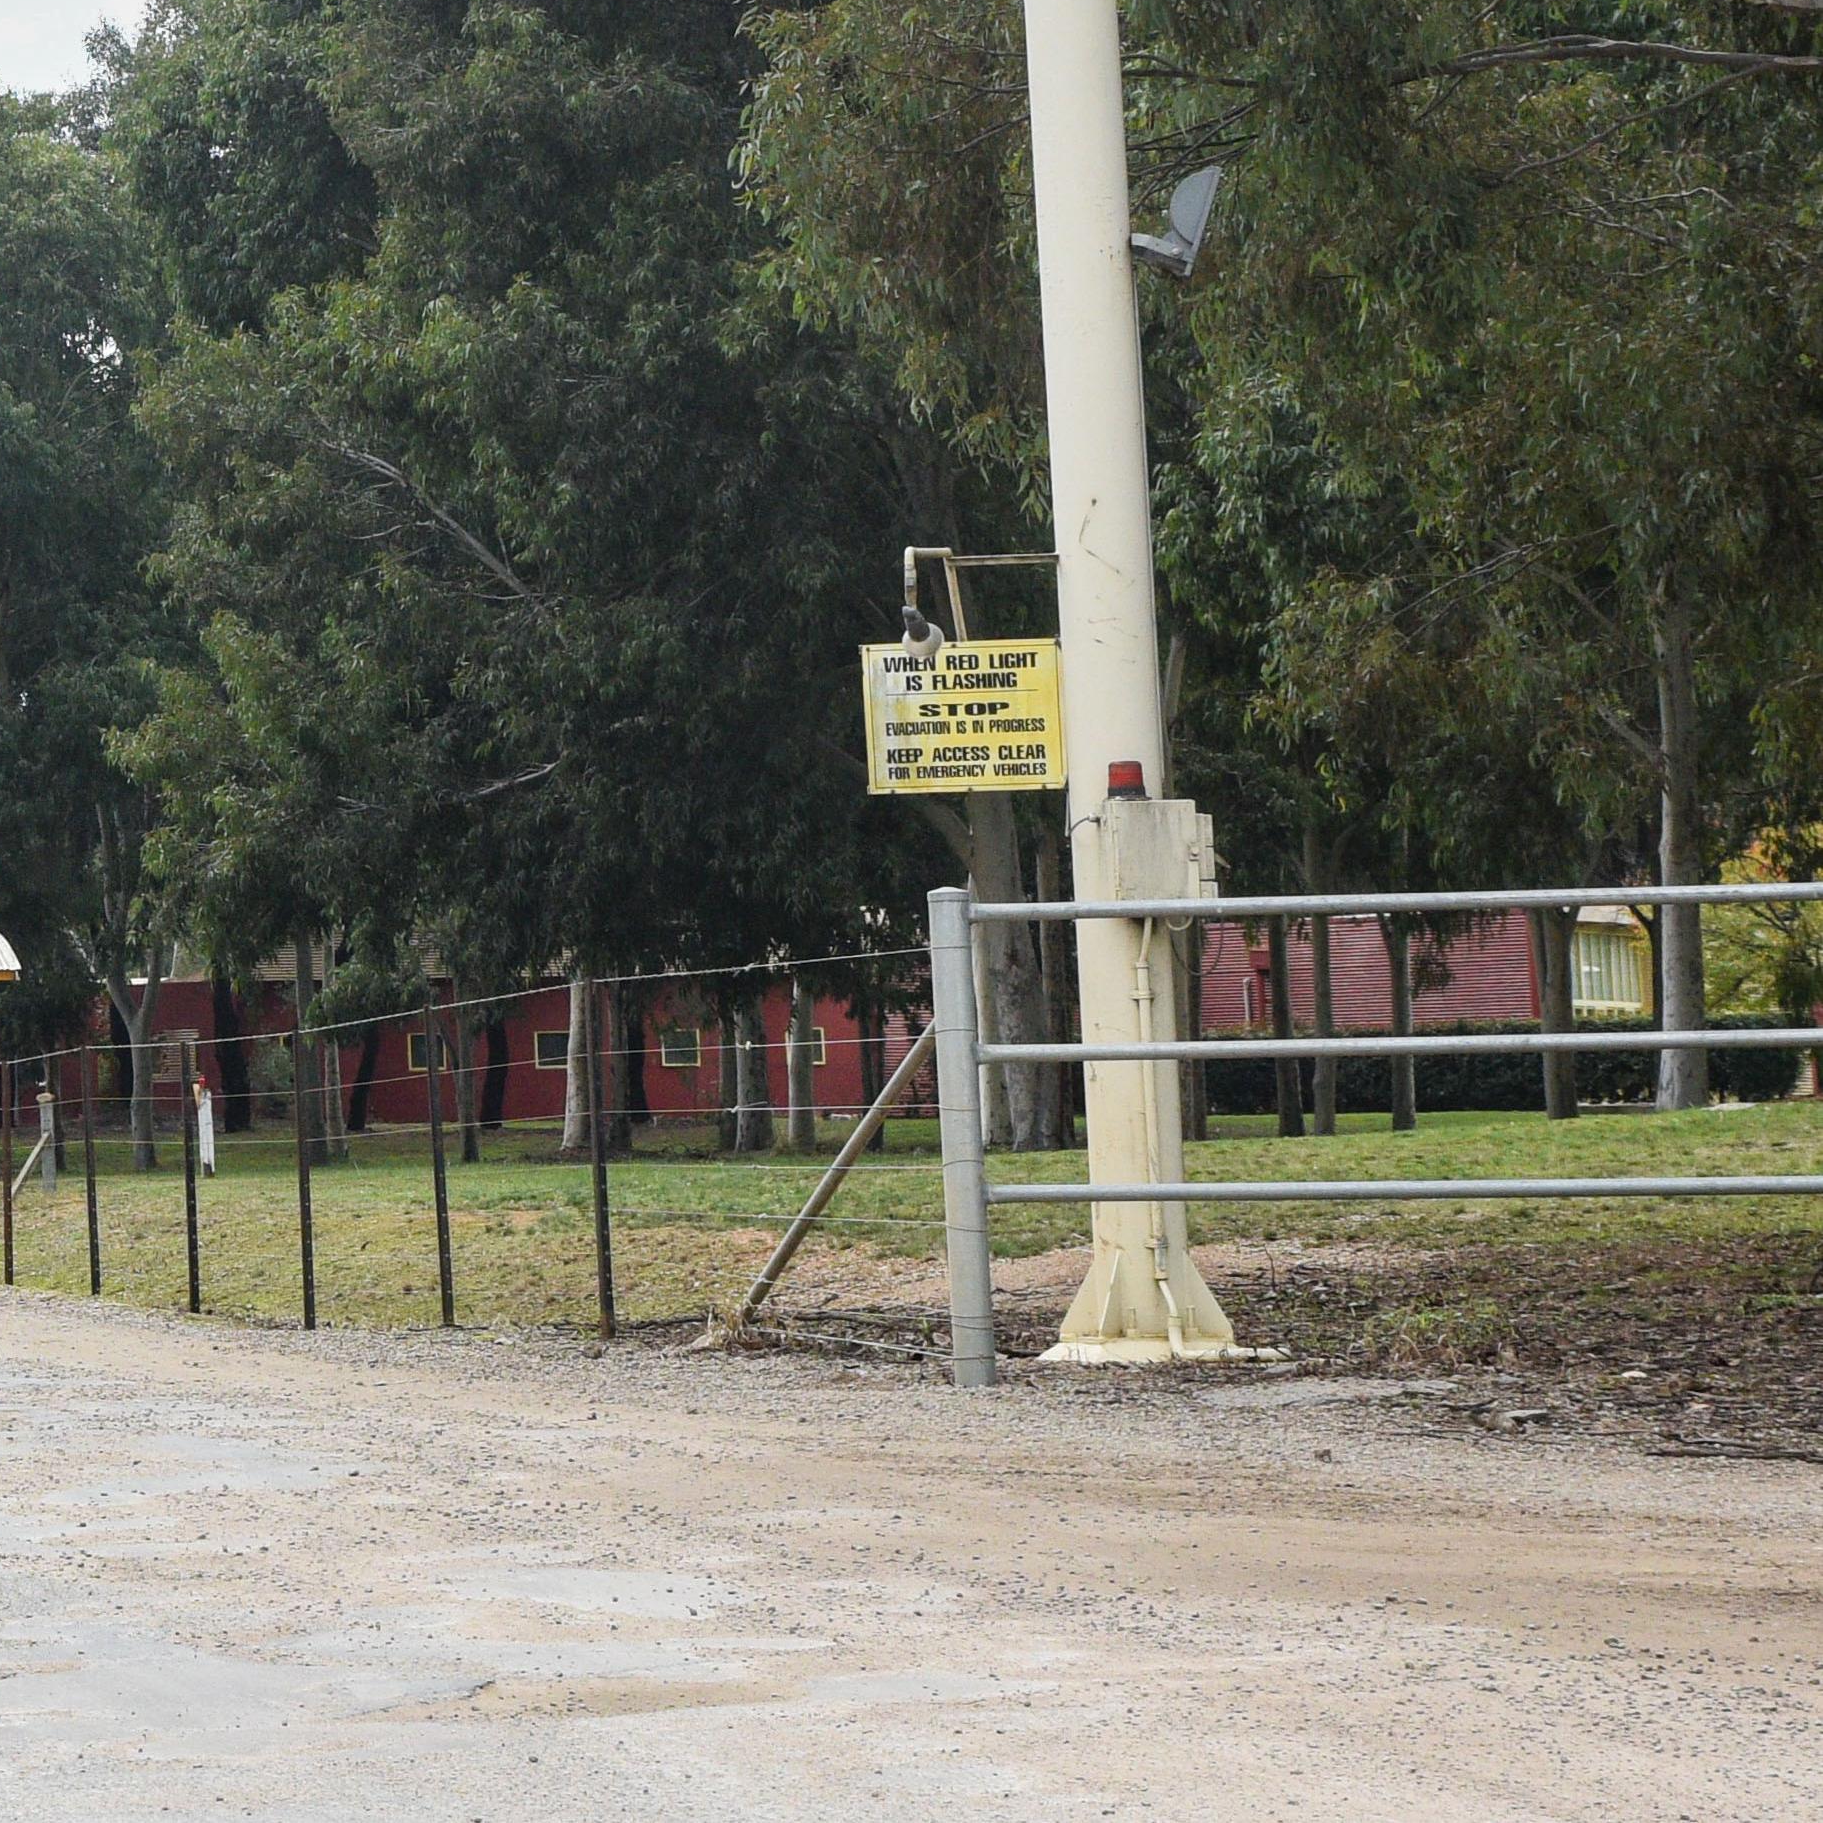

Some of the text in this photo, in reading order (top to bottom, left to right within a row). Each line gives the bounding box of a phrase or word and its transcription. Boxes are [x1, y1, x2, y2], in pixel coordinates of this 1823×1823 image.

[883, 652, 1038, 673] WHEN RED LIGHT
[906, 672, 1017, 691] IS FLASHING
[919, 702, 1009, 717] STOP
[886, 718, 1045, 736] EVACUATION IS IN PROGRESS
[887, 744, 1046, 764] KEEP ACCESS CLEAR
[888, 762, 1047, 780] FOR EMERGENCY VEHICLES
